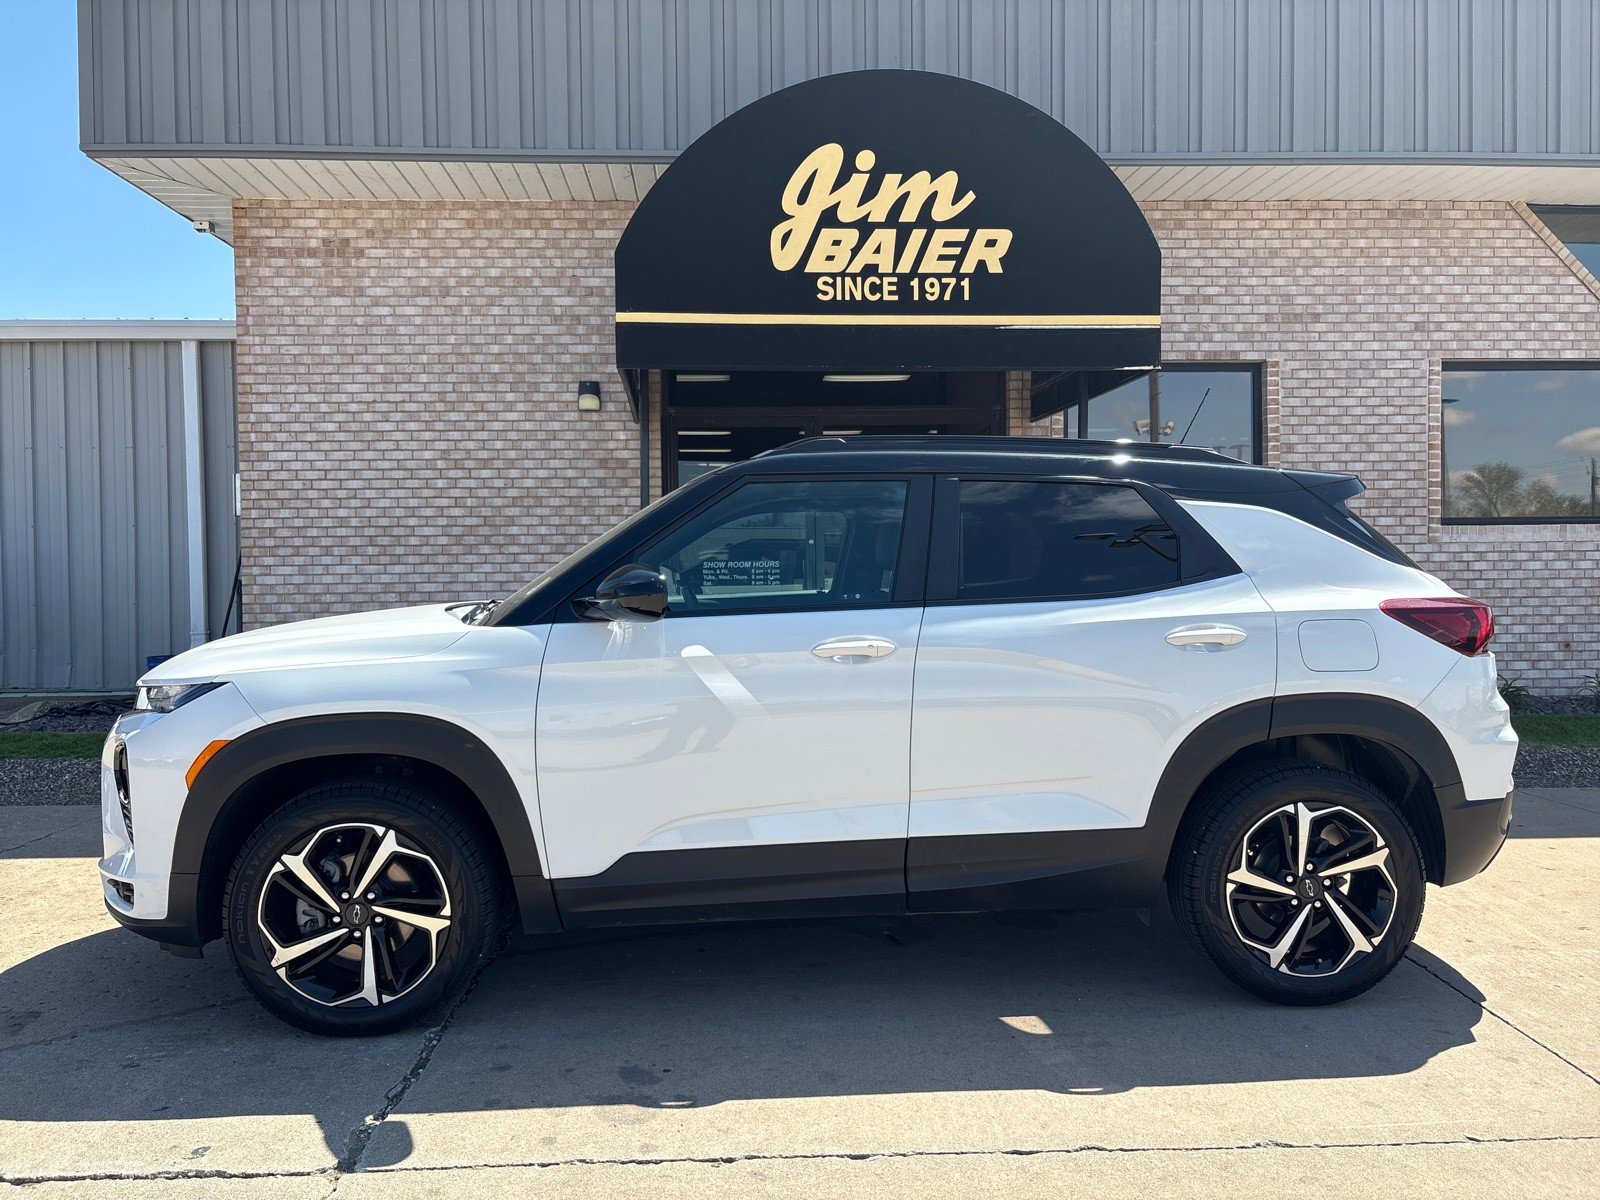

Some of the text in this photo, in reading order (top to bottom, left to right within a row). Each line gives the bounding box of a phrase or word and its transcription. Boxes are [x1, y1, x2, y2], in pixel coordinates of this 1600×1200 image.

[770, 142, 976, 272] Jim
[804, 228, 1013, 273] BAIER
[816, 276, 970, 301] SINCE 1971
[703, 561, 726, 569] SHOW
